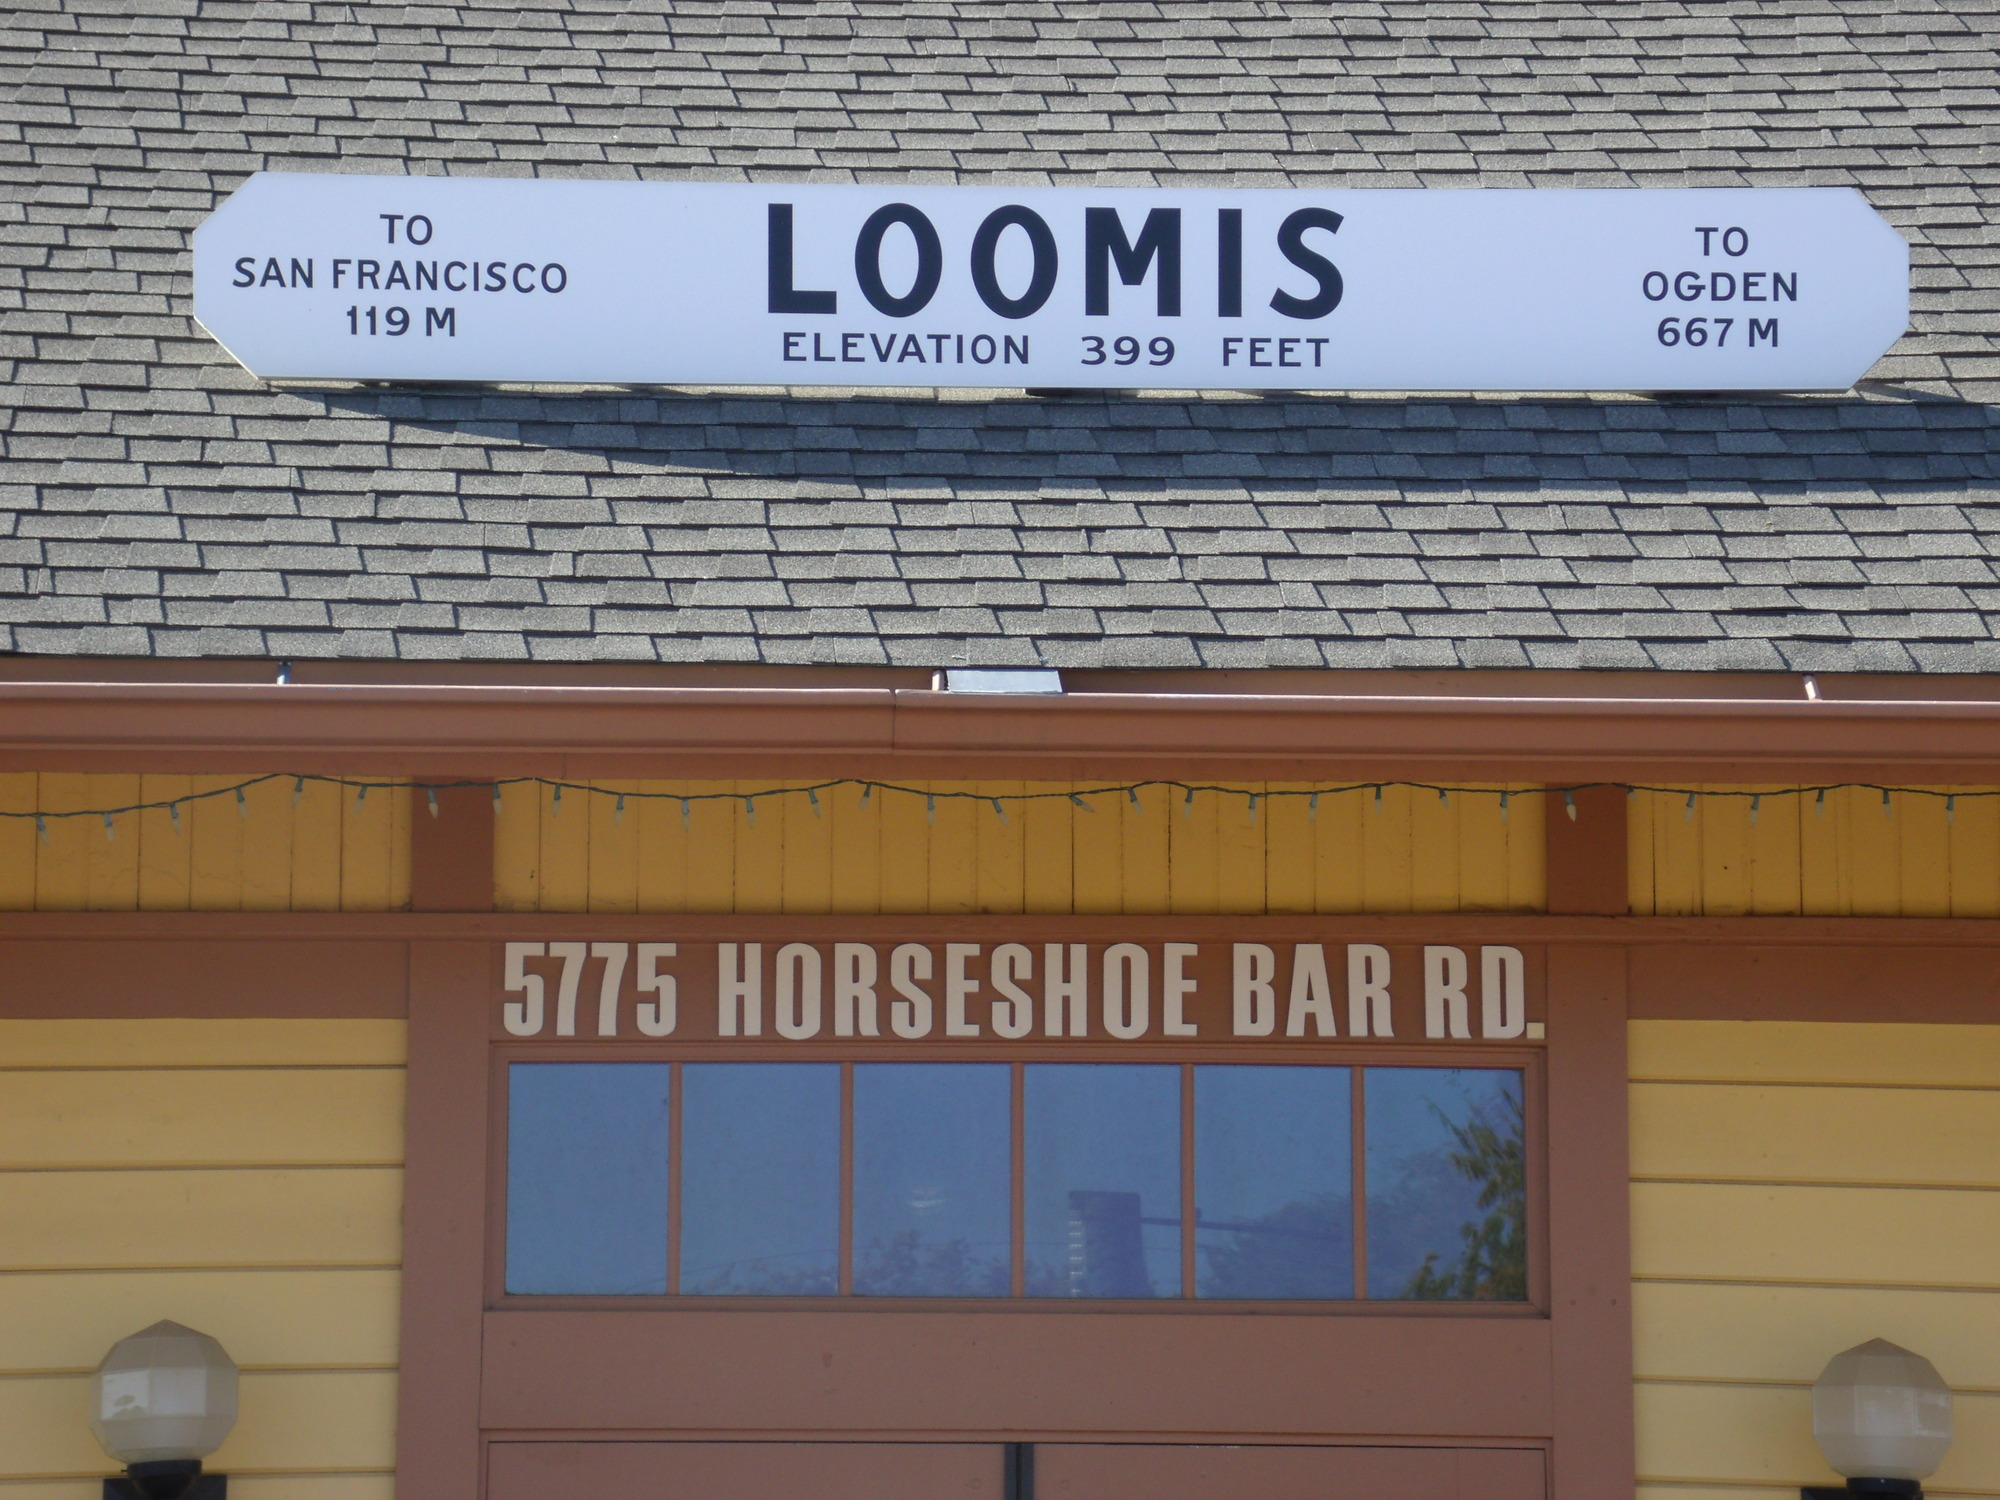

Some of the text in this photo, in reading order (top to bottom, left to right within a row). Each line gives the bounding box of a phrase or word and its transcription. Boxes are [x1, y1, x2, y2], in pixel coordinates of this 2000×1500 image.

[379, 213, 433, 246] TO
[1694, 226, 1749, 257] TO
[232, 256, 568, 294] SAN FRANCISCO
[767, 202, 1345, 320] LOOMIS
[1642, 270, 1797, 302] OGDEN
[346, 305, 456, 337] 119 M
[1657, 316, 1779, 348] 667 M
[783, 331, 1330, 368] ELEVATION 399 FEET
[503, 941, 1545, 1041] 5775 HORSESHOE BAR RD.
